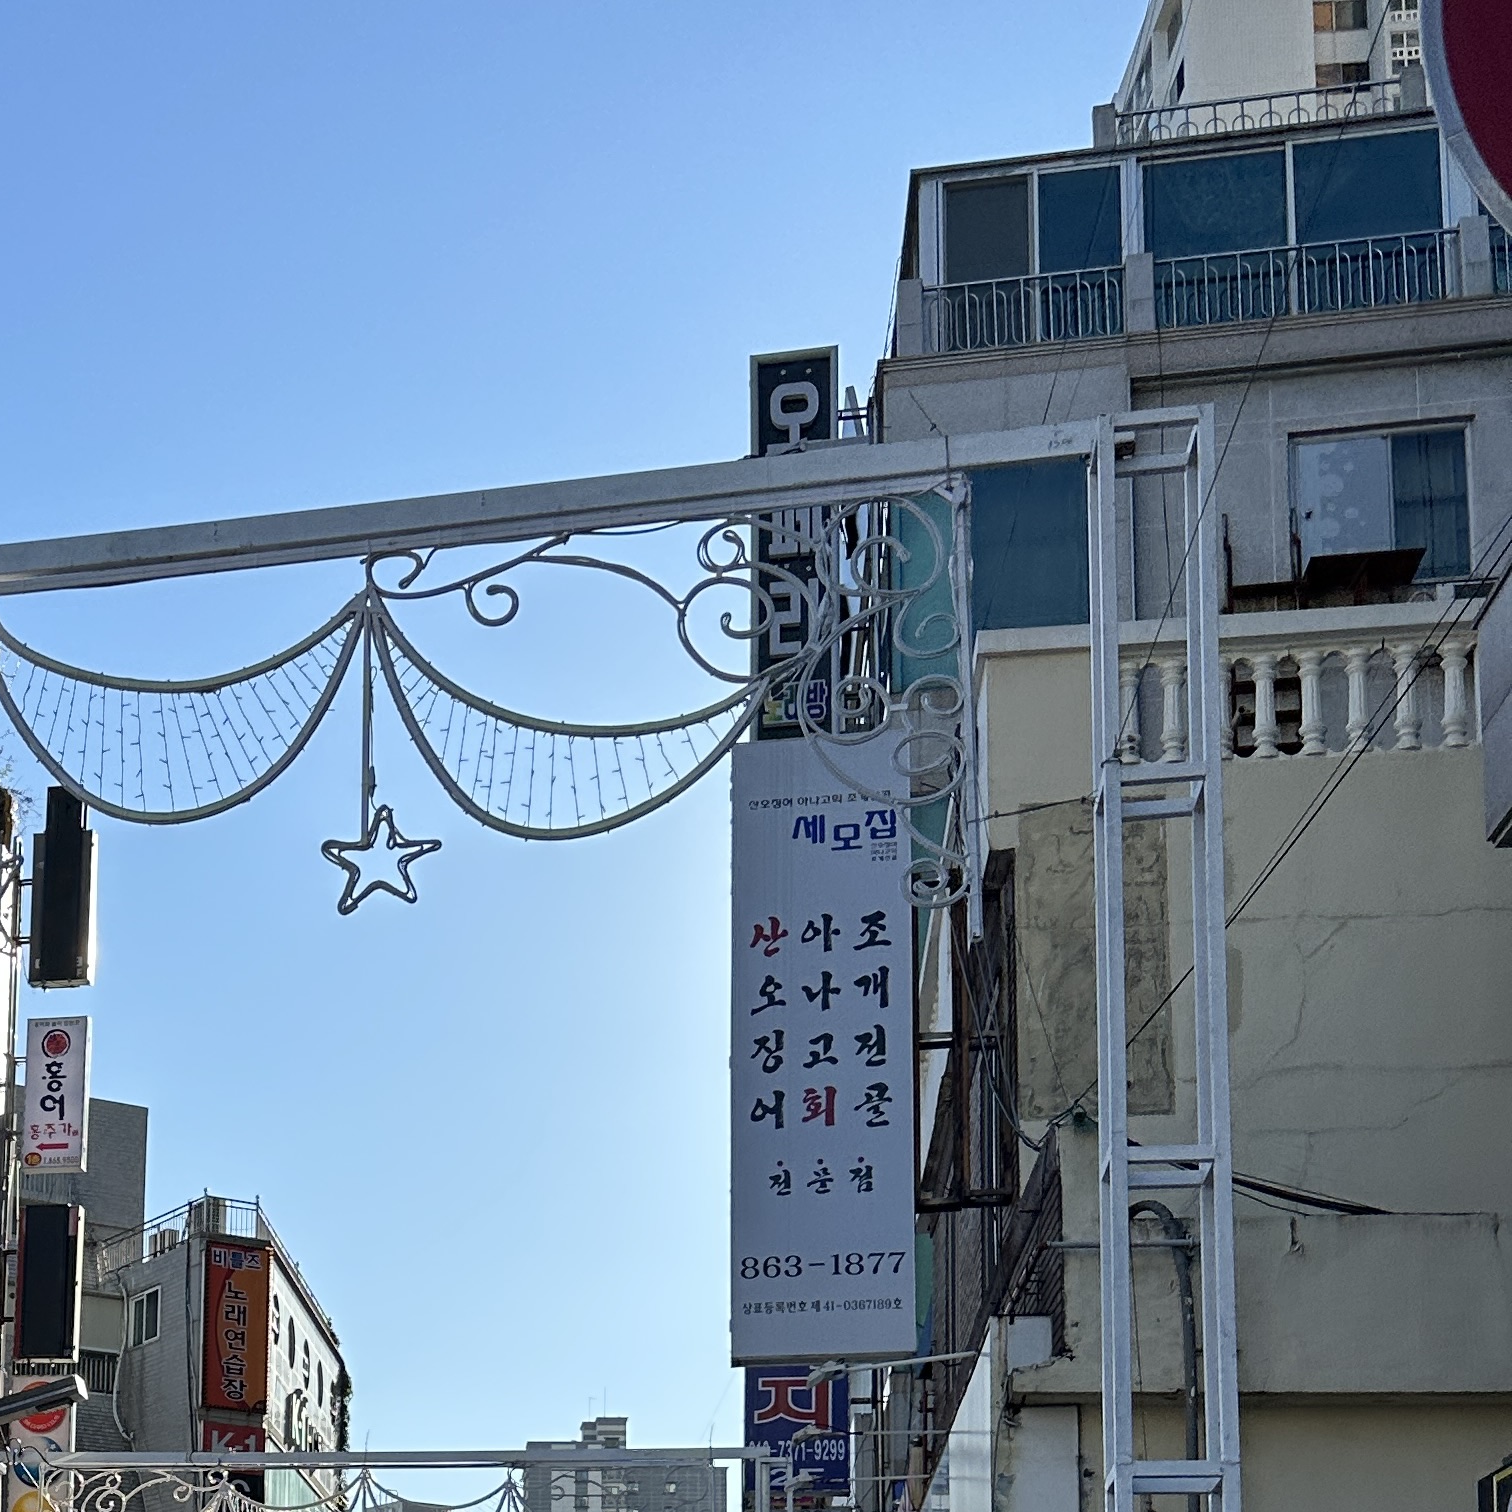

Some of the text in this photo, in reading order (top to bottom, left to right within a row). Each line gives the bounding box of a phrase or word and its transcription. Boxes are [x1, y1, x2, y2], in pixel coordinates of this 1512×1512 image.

[792, 808, 897, 851] 세모집
[750, 916, 789, 1129] 산오징어
[801, 913, 841, 1127] 아나고회
[39, 1061, 67, 1121] 홍어
[769, 1160, 874, 1196] 전문점
[740, 1252, 906, 1280] 863-1877
[222, 1279, 248, 1401] 노래연습장
